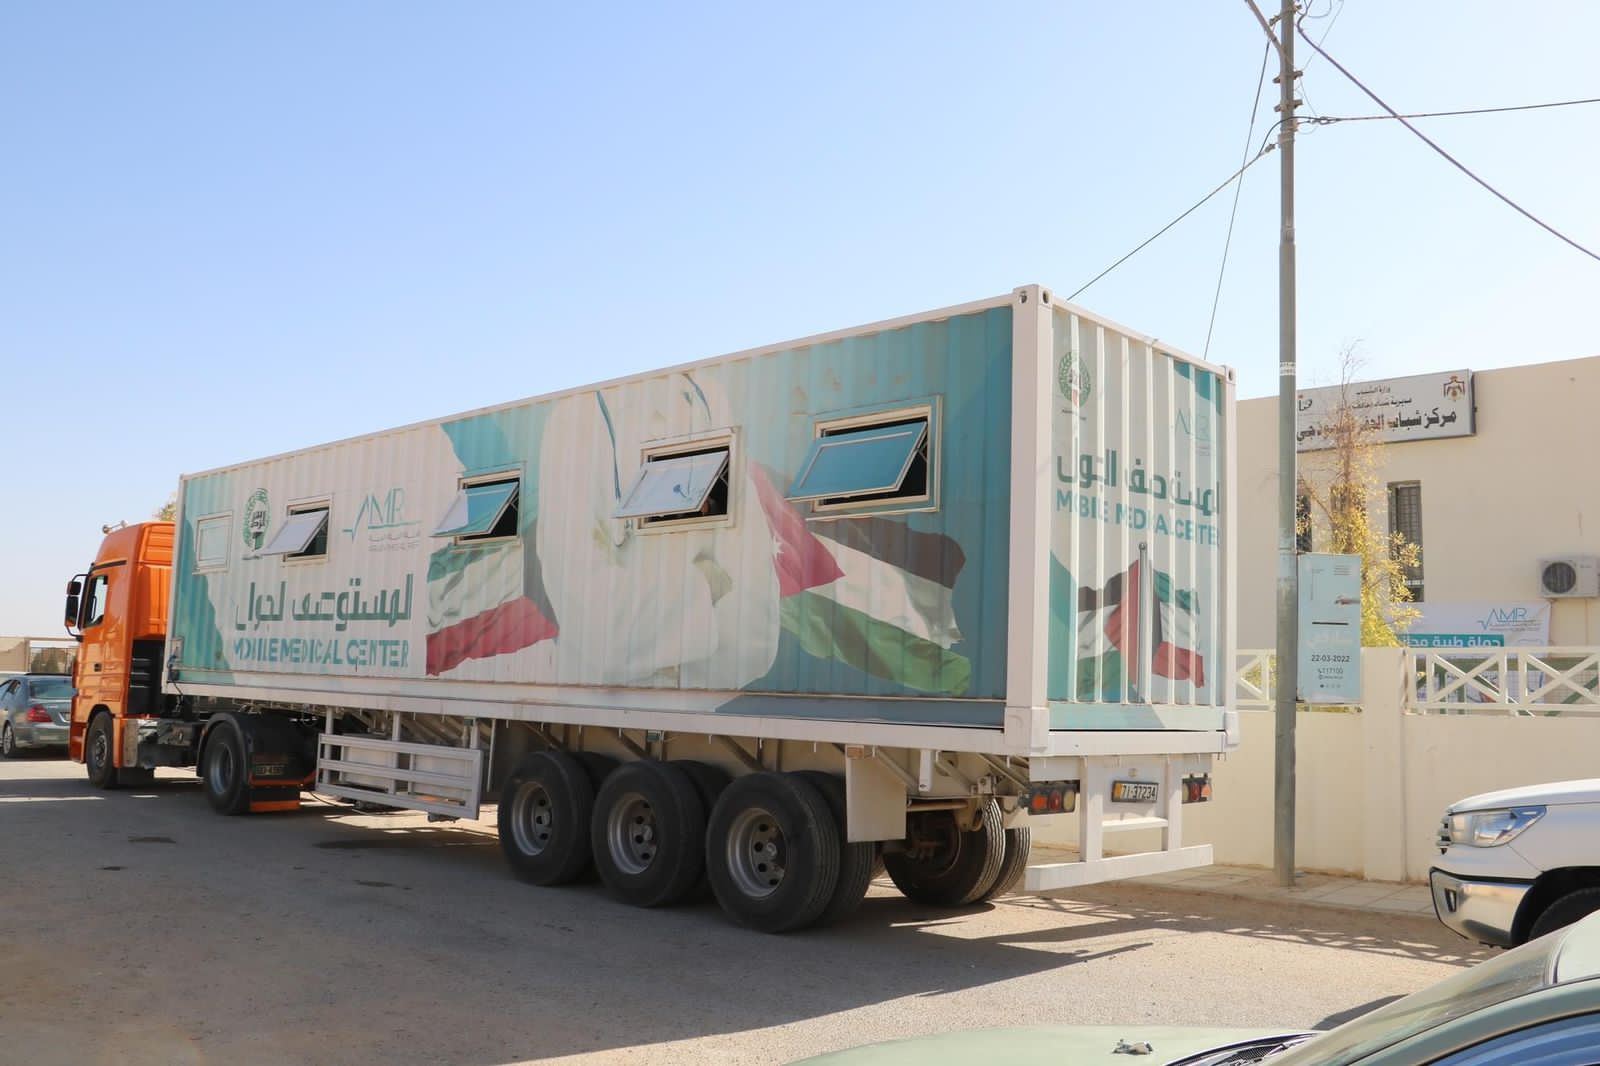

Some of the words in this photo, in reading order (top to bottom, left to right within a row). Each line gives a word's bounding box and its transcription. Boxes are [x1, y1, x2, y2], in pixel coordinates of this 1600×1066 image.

[1387, 410, 1422, 432] شباب
[1423, 407, 1457, 429] مركز
[346, 638, 409, 668] CENTER
[1311, 654, 1350, 662] 22-03-2022
[1120, 784, 1157, 799] 71-37234
